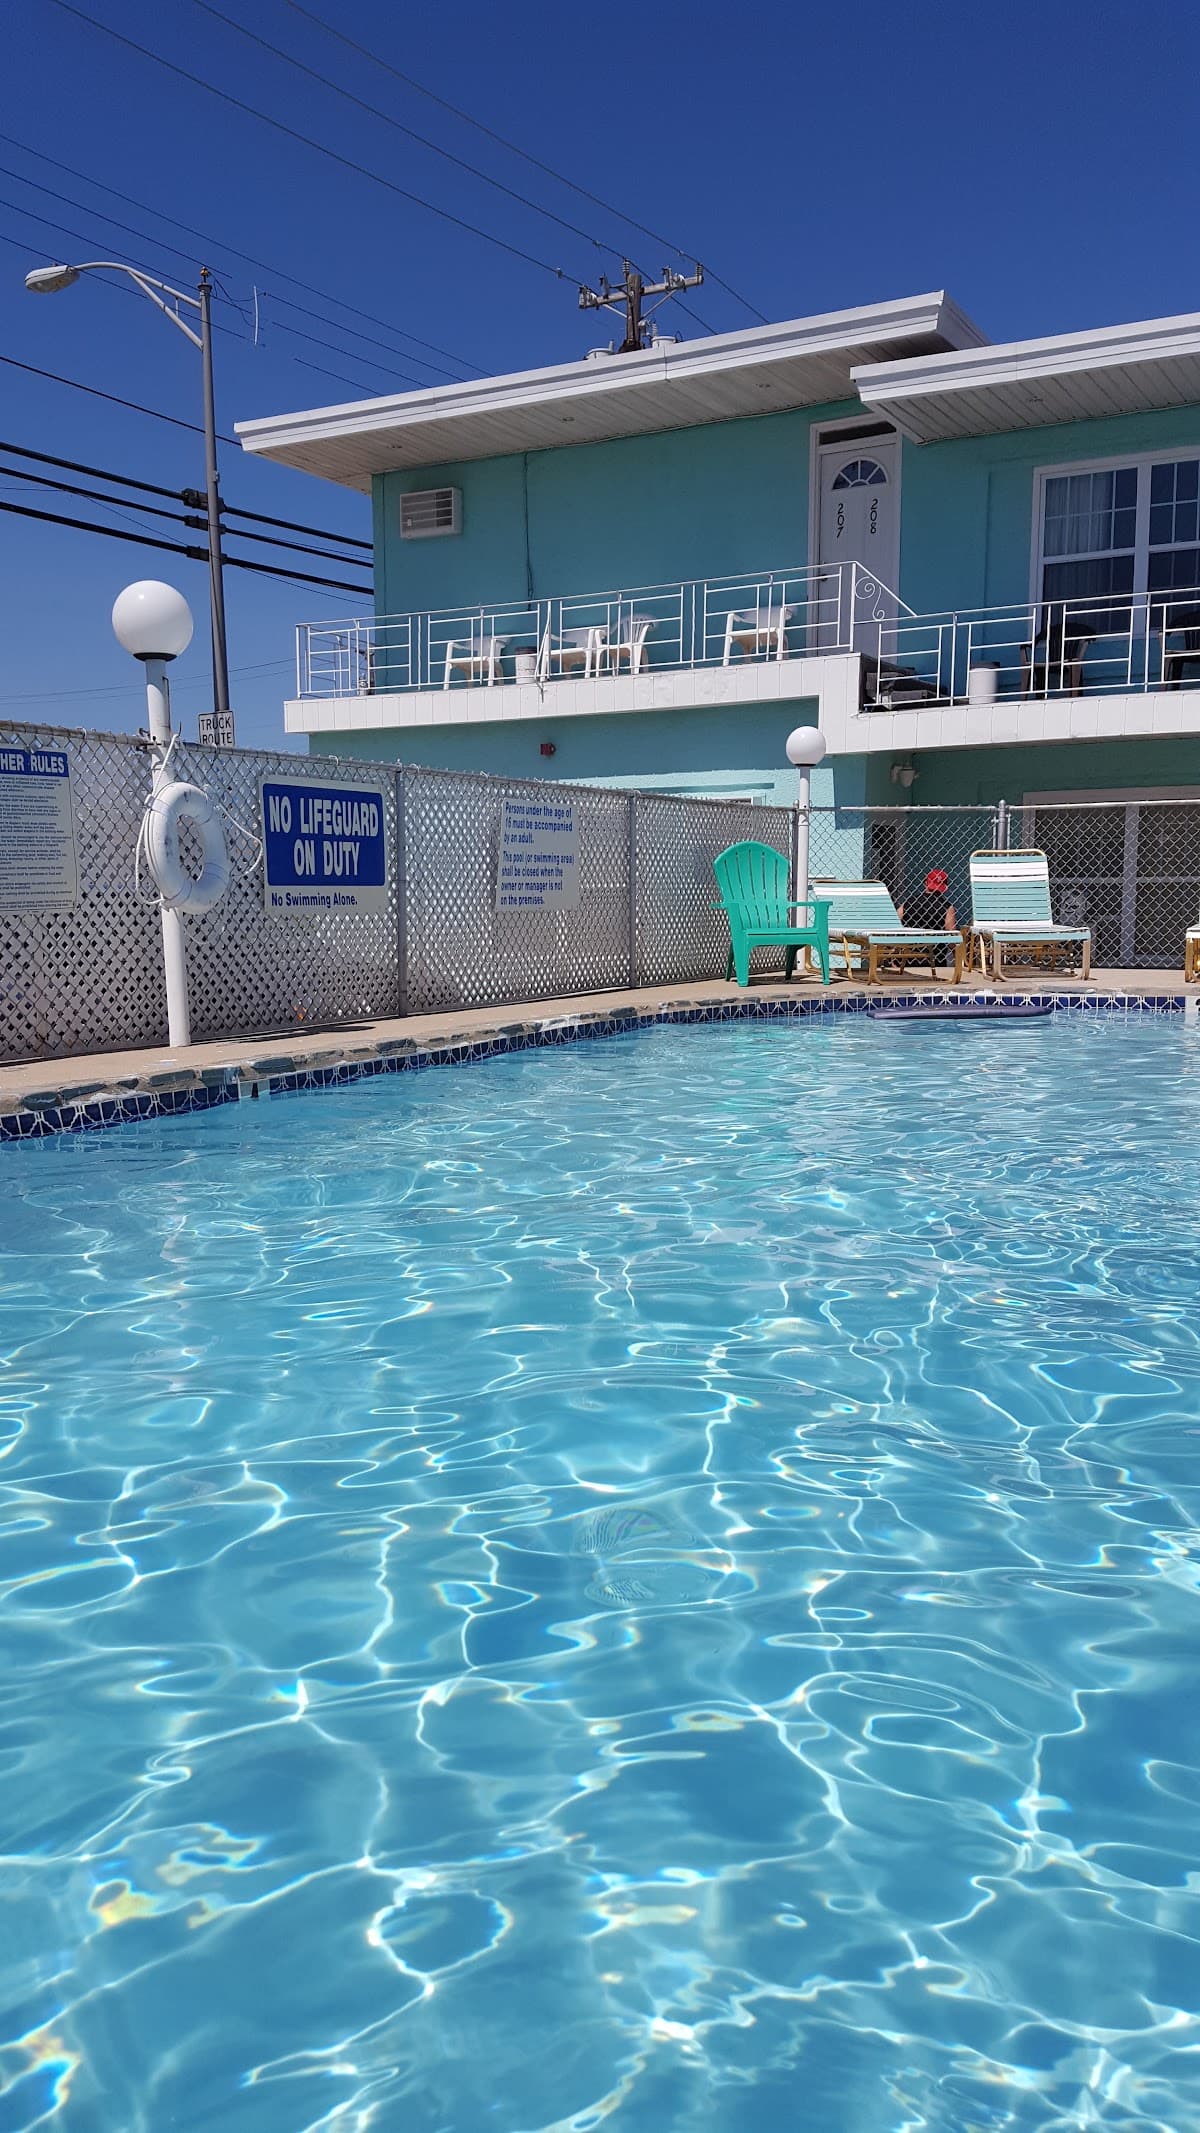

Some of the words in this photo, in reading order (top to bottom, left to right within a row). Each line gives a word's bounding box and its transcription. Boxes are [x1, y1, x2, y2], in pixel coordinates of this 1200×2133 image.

[836, 502, 845, 539] 207
[870, 498, 879, 535] 208
[200, 716, 232, 731] TRUCK
[202, 732, 233, 746] ROUTE
[30, 754, 65, 774] RULES
[268, 795, 292, 834] NO
[300, 797, 379, 837] LIFEGUARD
[505, 801, 525, 815] Persons
[525, 804, 542, 816] under
[543, 805, 553, 817] the
[554, 808, 565, 820] age
[565, 807, 572, 819] of
[512, 818, 525, 830] must
[526, 818, 533, 831] be
[534, 821, 573, 833] accompanied
[503, 832, 510, 845] by
[510, 834, 518, 843] an
[518, 832, 535, 844] adult.
[293, 838, 316, 877] ON
[323, 840, 360, 877] DUTY
[503, 850, 513, 863] This
[513, 852, 524, 865] pool
[533, 852, 560, 866] swimming
[501, 865, 514, 877] shall
[514, 866, 521, 877] be
[521, 865, 540, 877] closed
[540, 866, 555, 878] when
[555, 866, 564, 878] the
[500, 881, 517, 892] owner
[517, 882, 524, 891] or
[524, 881, 548, 893] manager
[548, 880, 554, 891] is
[554, 880, 563, 892] not
[271, 892, 283, 907] No
[285, 892, 331, 909] Swimming
[333, 893, 358, 906] Alone.
[500, 896, 508, 905] on
[508, 893, 518, 905] the
[518, 895, 545, 907] premises.
